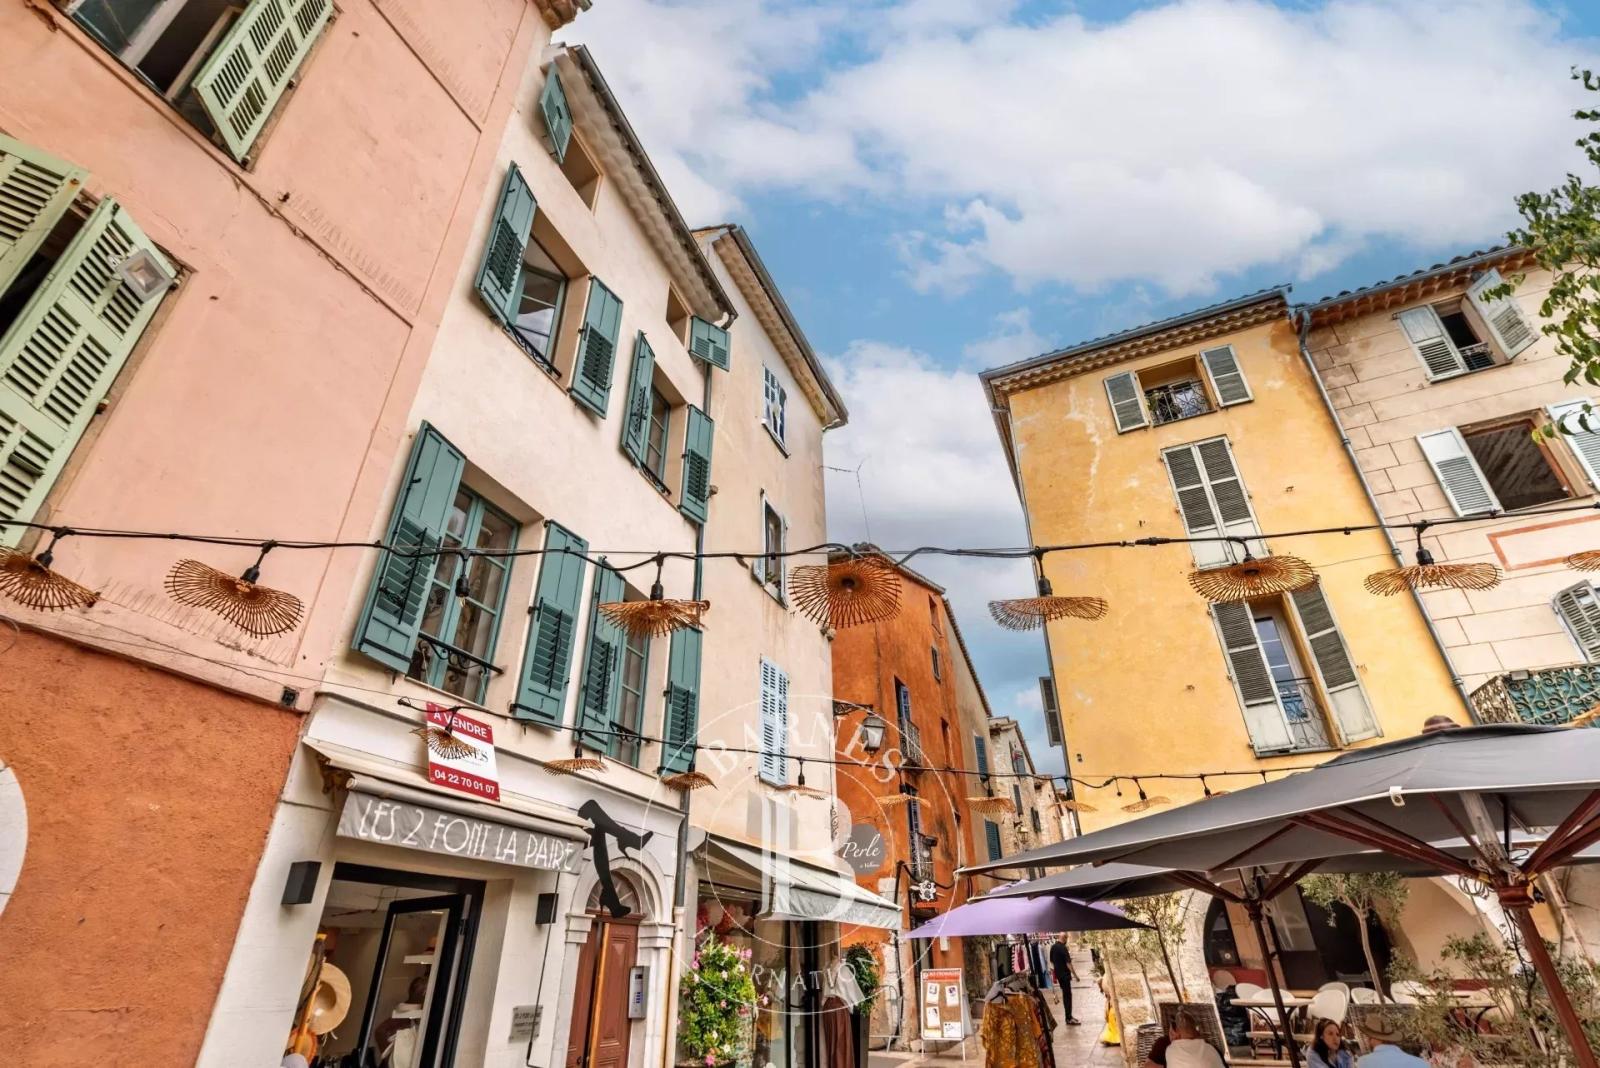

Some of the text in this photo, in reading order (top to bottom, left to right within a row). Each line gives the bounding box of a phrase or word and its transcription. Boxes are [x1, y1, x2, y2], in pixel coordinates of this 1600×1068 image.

[443, 712, 488, 738] VENDRE
[434, 769, 495, 795] 04 22 70 01 07
[358, 800, 575, 871] LES 2 FONT LA PAIRE
[842, 833, 881, 859] Perle
